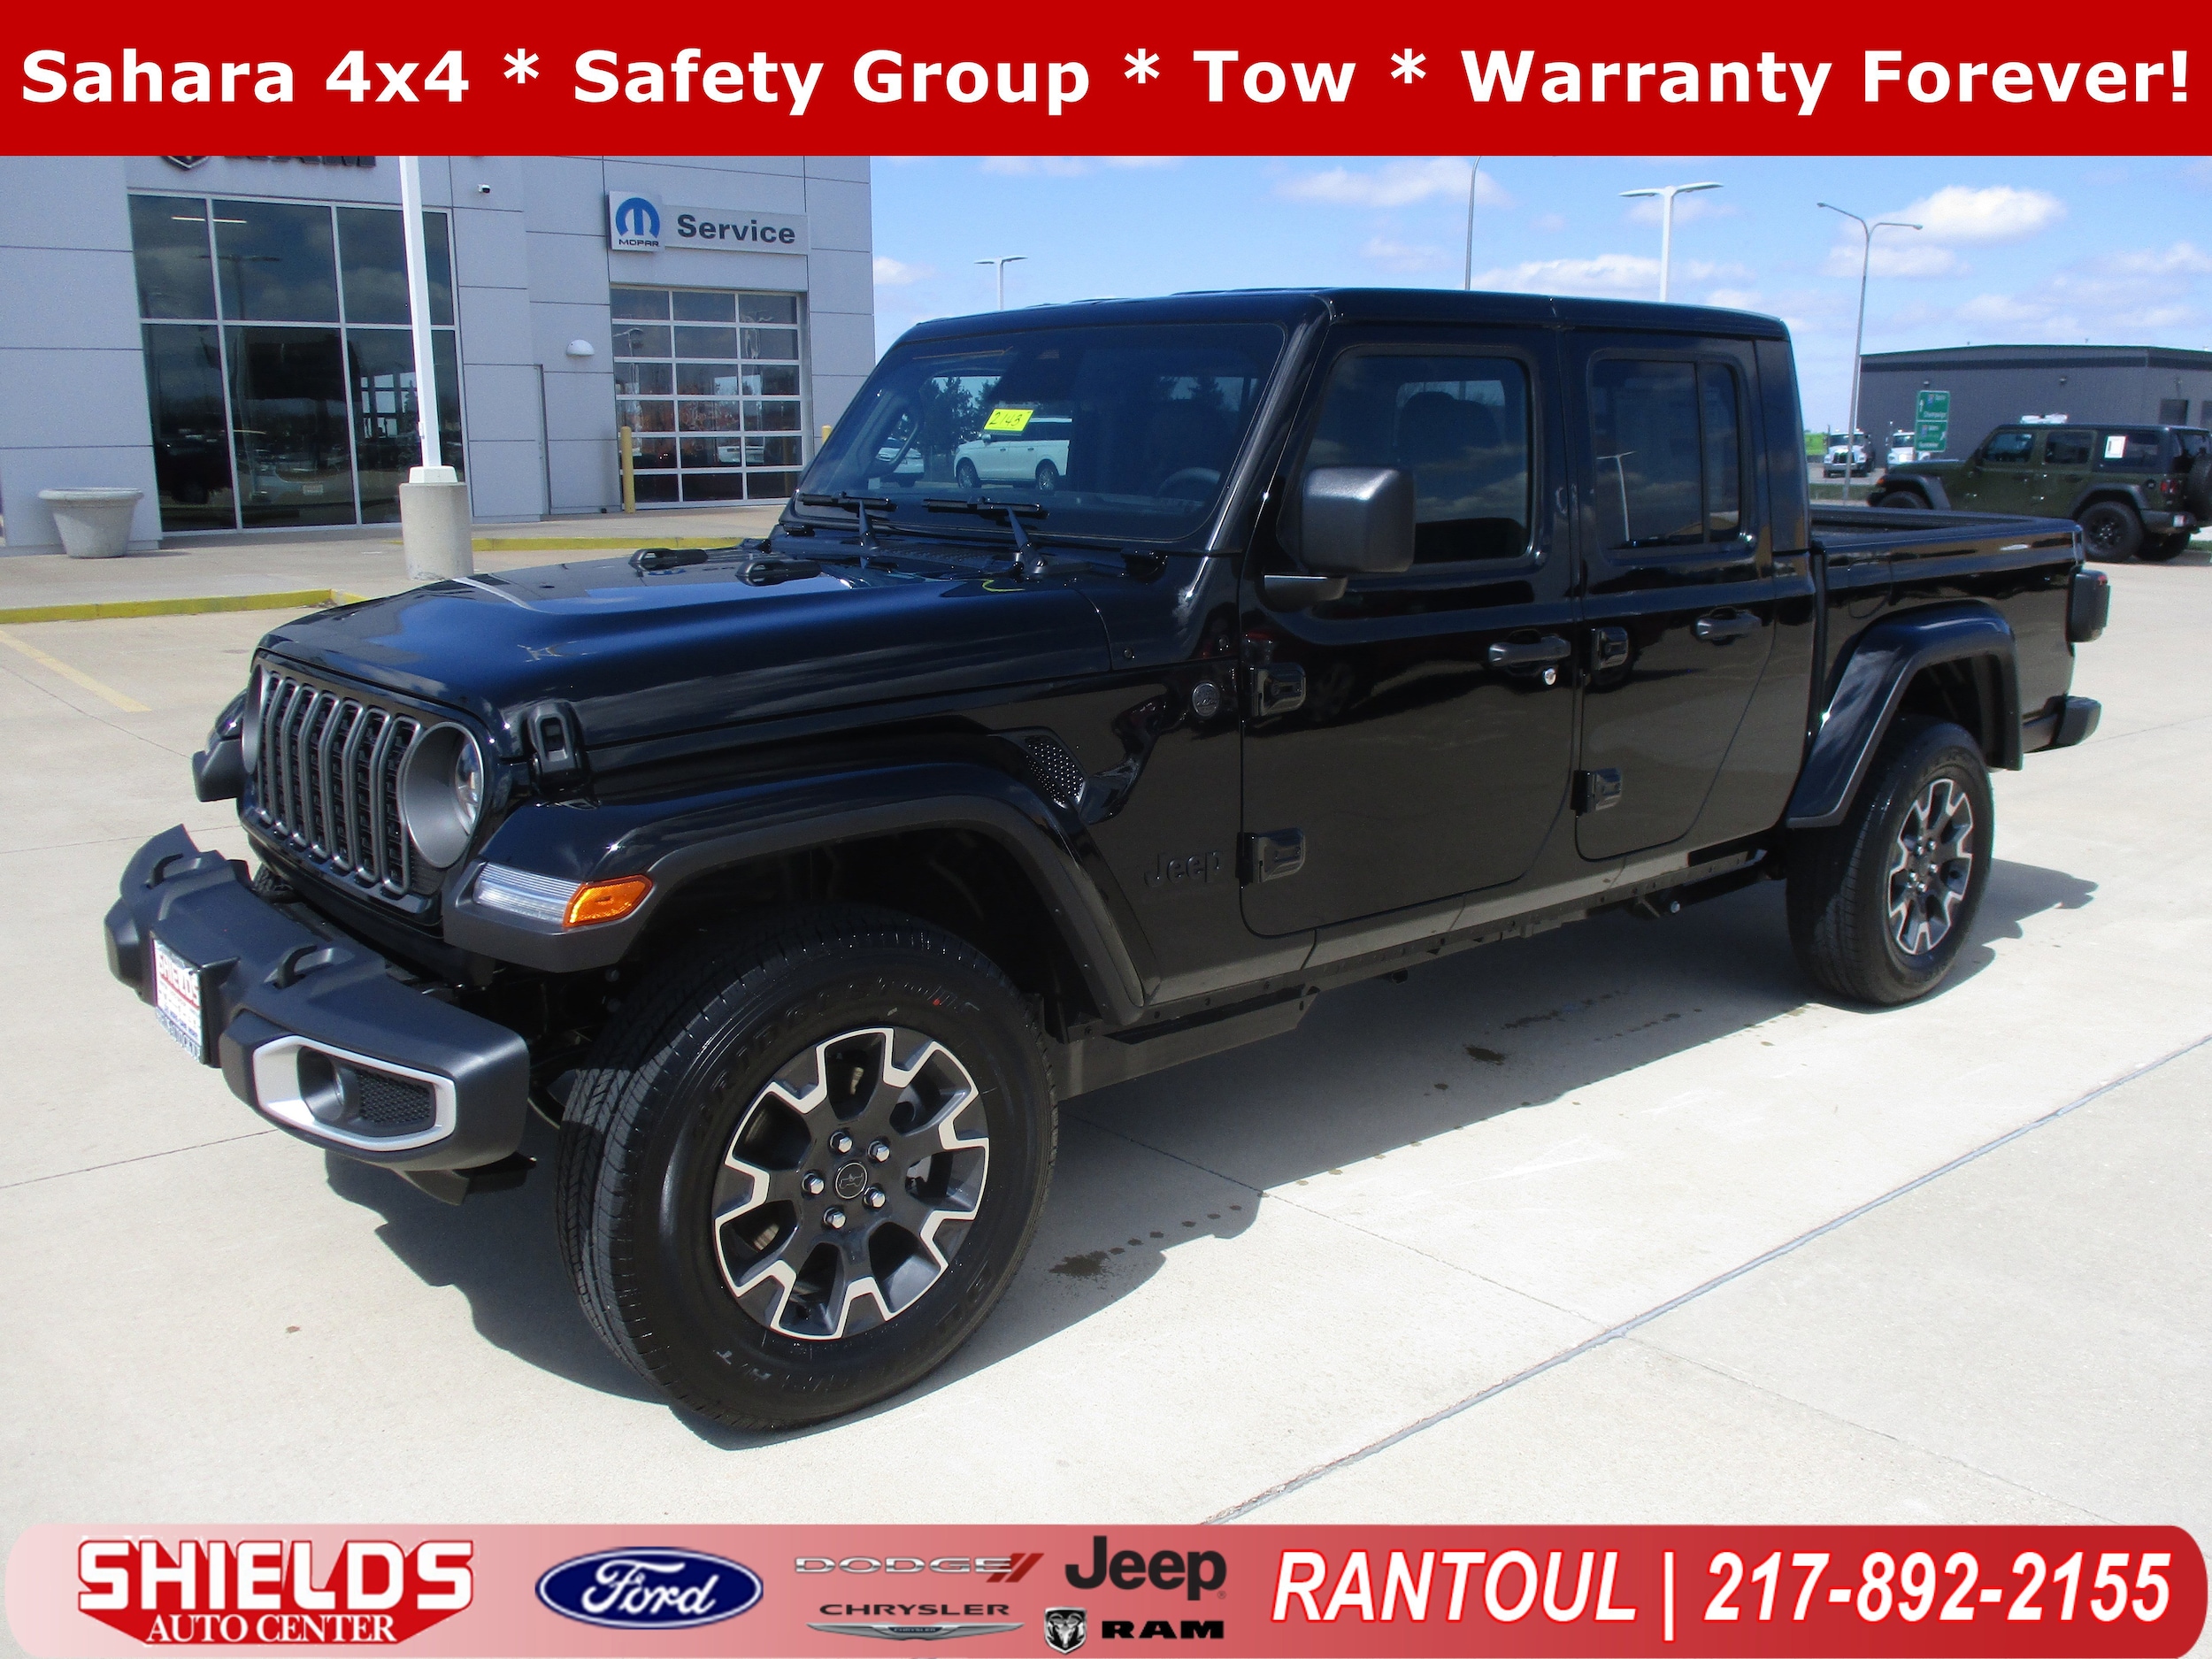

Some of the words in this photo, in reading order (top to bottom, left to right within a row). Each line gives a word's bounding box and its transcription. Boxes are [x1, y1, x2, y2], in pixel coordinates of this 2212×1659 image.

[618, 238, 660, 248] MOPAR
[677, 213, 795, 244] Service
[1144, 850, 1223, 887] Jeep
